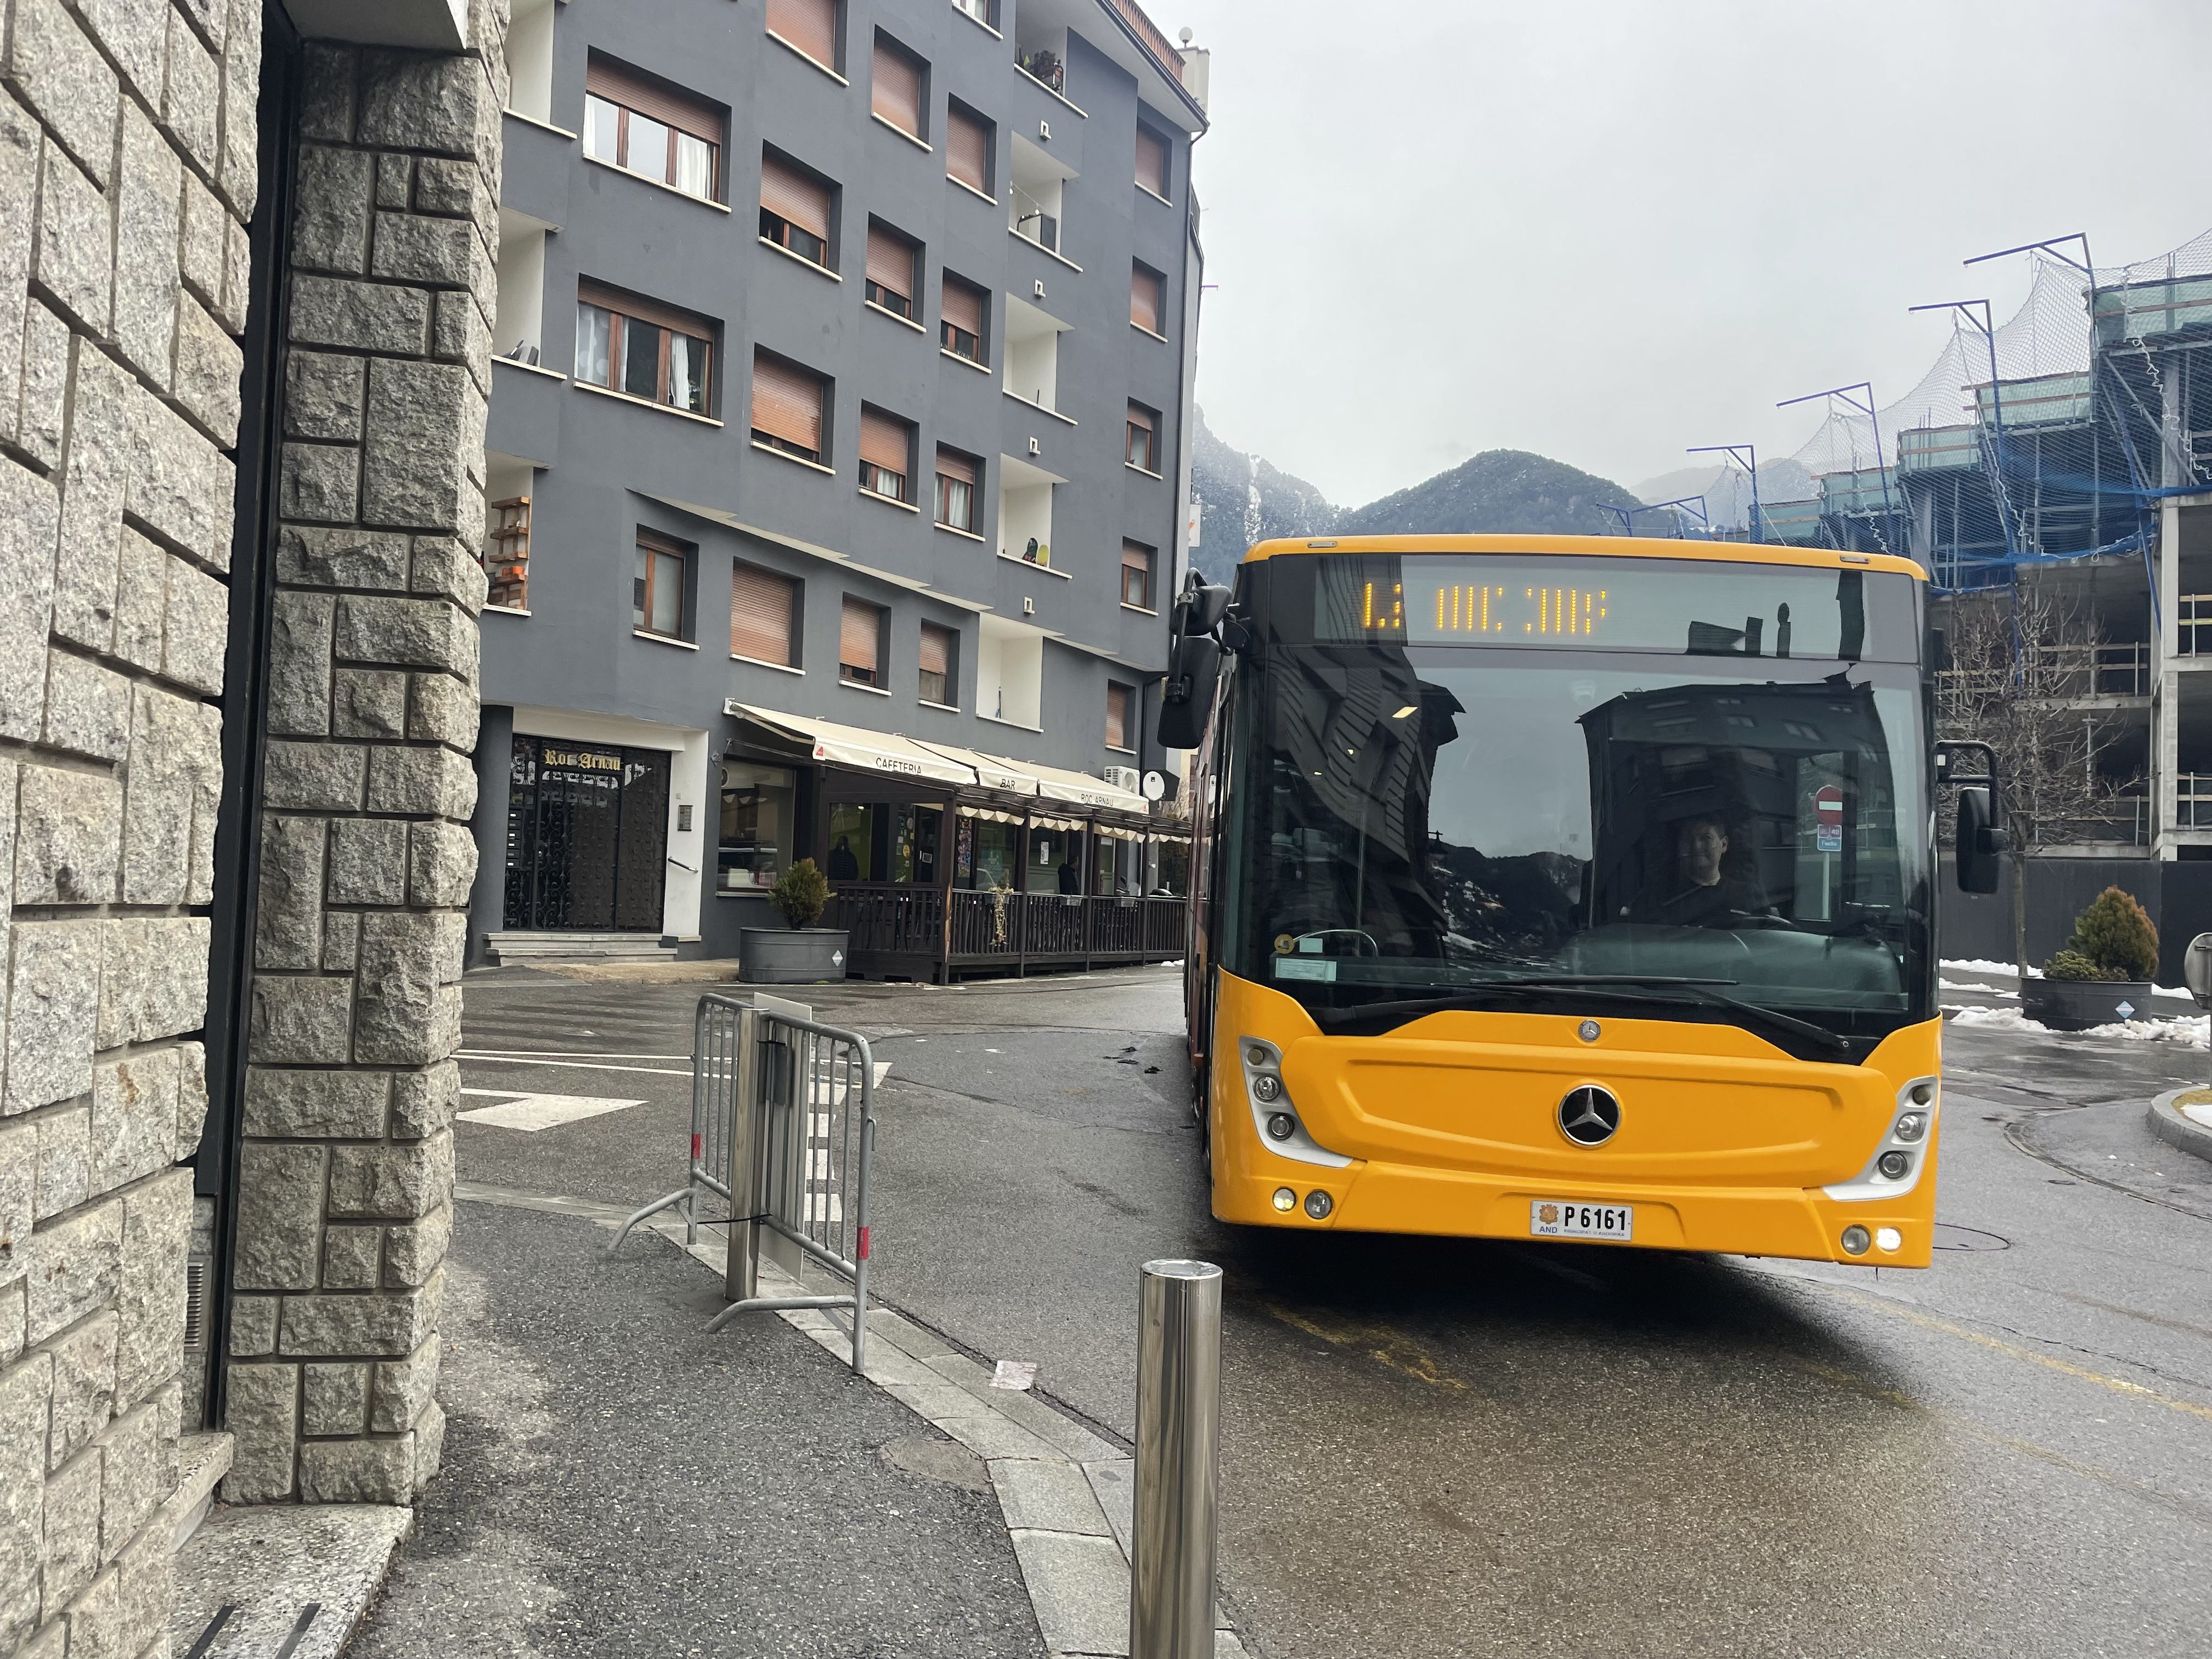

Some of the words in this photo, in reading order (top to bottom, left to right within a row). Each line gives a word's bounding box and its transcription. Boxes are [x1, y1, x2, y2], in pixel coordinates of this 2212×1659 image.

[544, 748, 572, 766] Roc
[577, 752, 621, 771] Arnau
[876, 757, 922, 775] CAFETERIA
[999, 778, 1015, 791] BAR
[1081, 793, 1093, 804] ROC
[1094, 796, 1114, 808] ARNAU
[1564, 1205, 1575, 1227] P
[1580, 1207, 1626, 1231] 6161
[1538, 1226, 1558, 1234] AND
